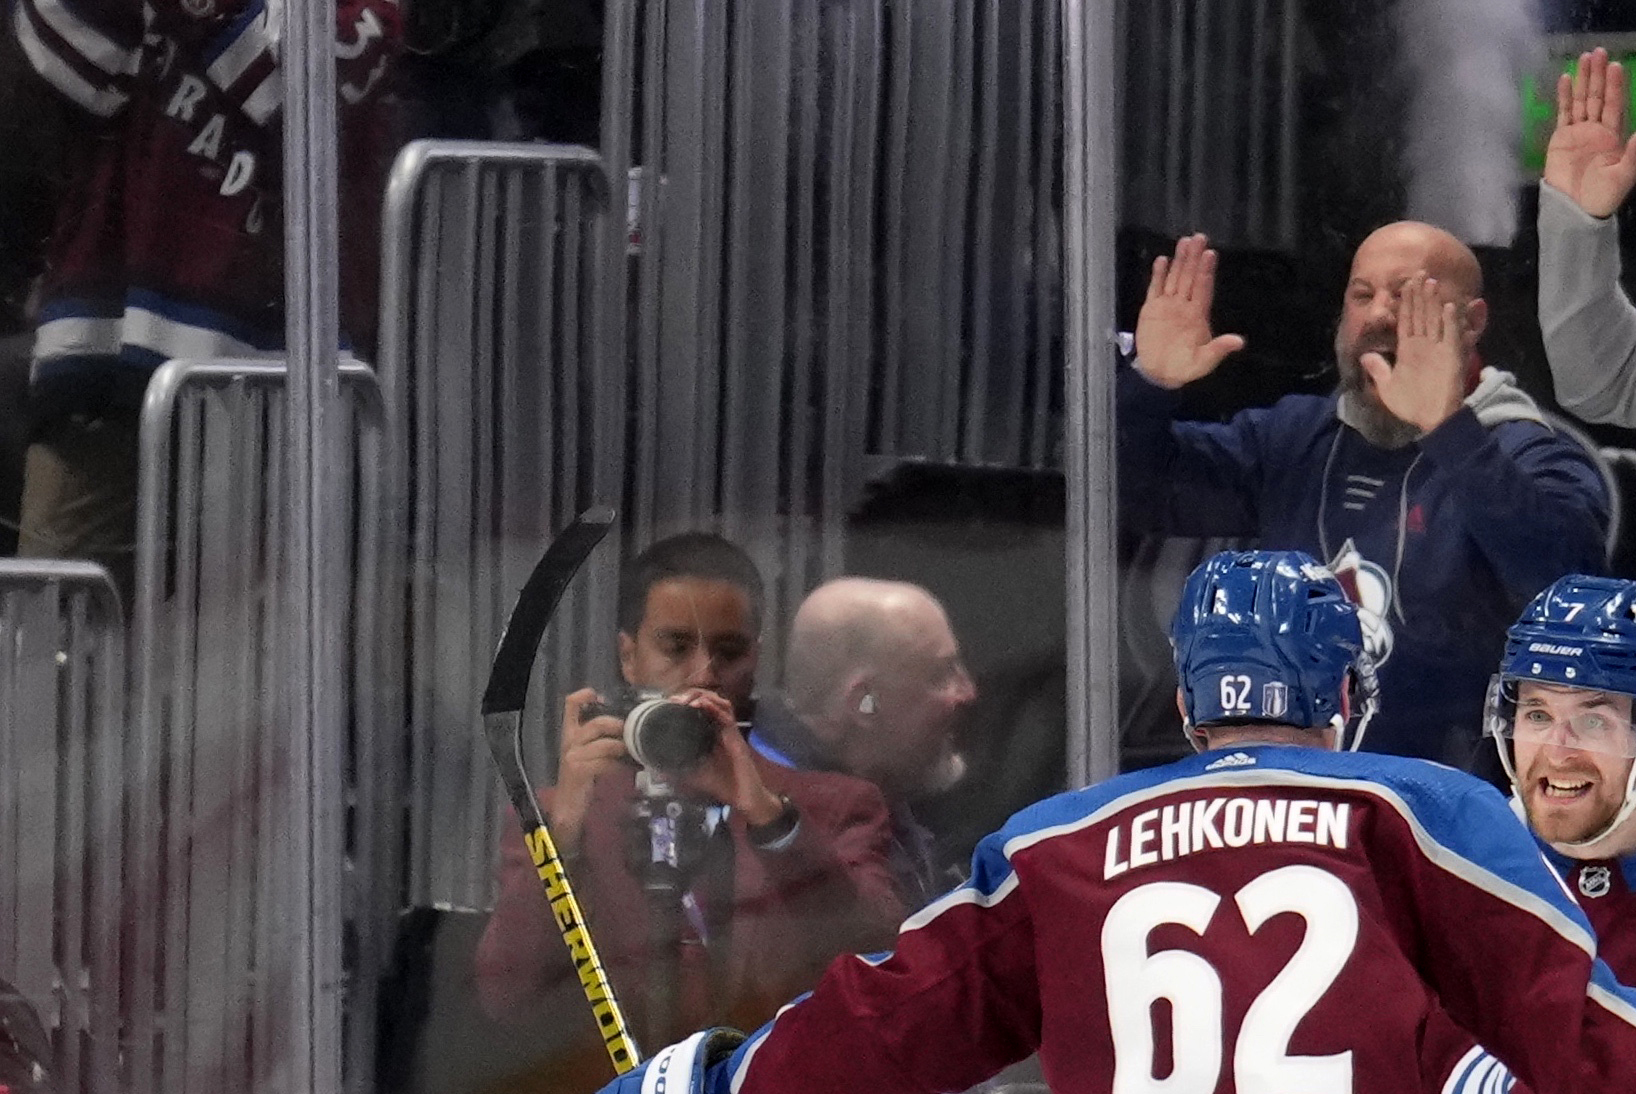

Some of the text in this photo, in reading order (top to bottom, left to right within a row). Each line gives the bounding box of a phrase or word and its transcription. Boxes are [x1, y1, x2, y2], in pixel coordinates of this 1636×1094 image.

[1564, 602, 1585, 622] 7
[1220, 674, 1252, 710] 62
[1103, 797, 1351, 881] LEHKONEN
